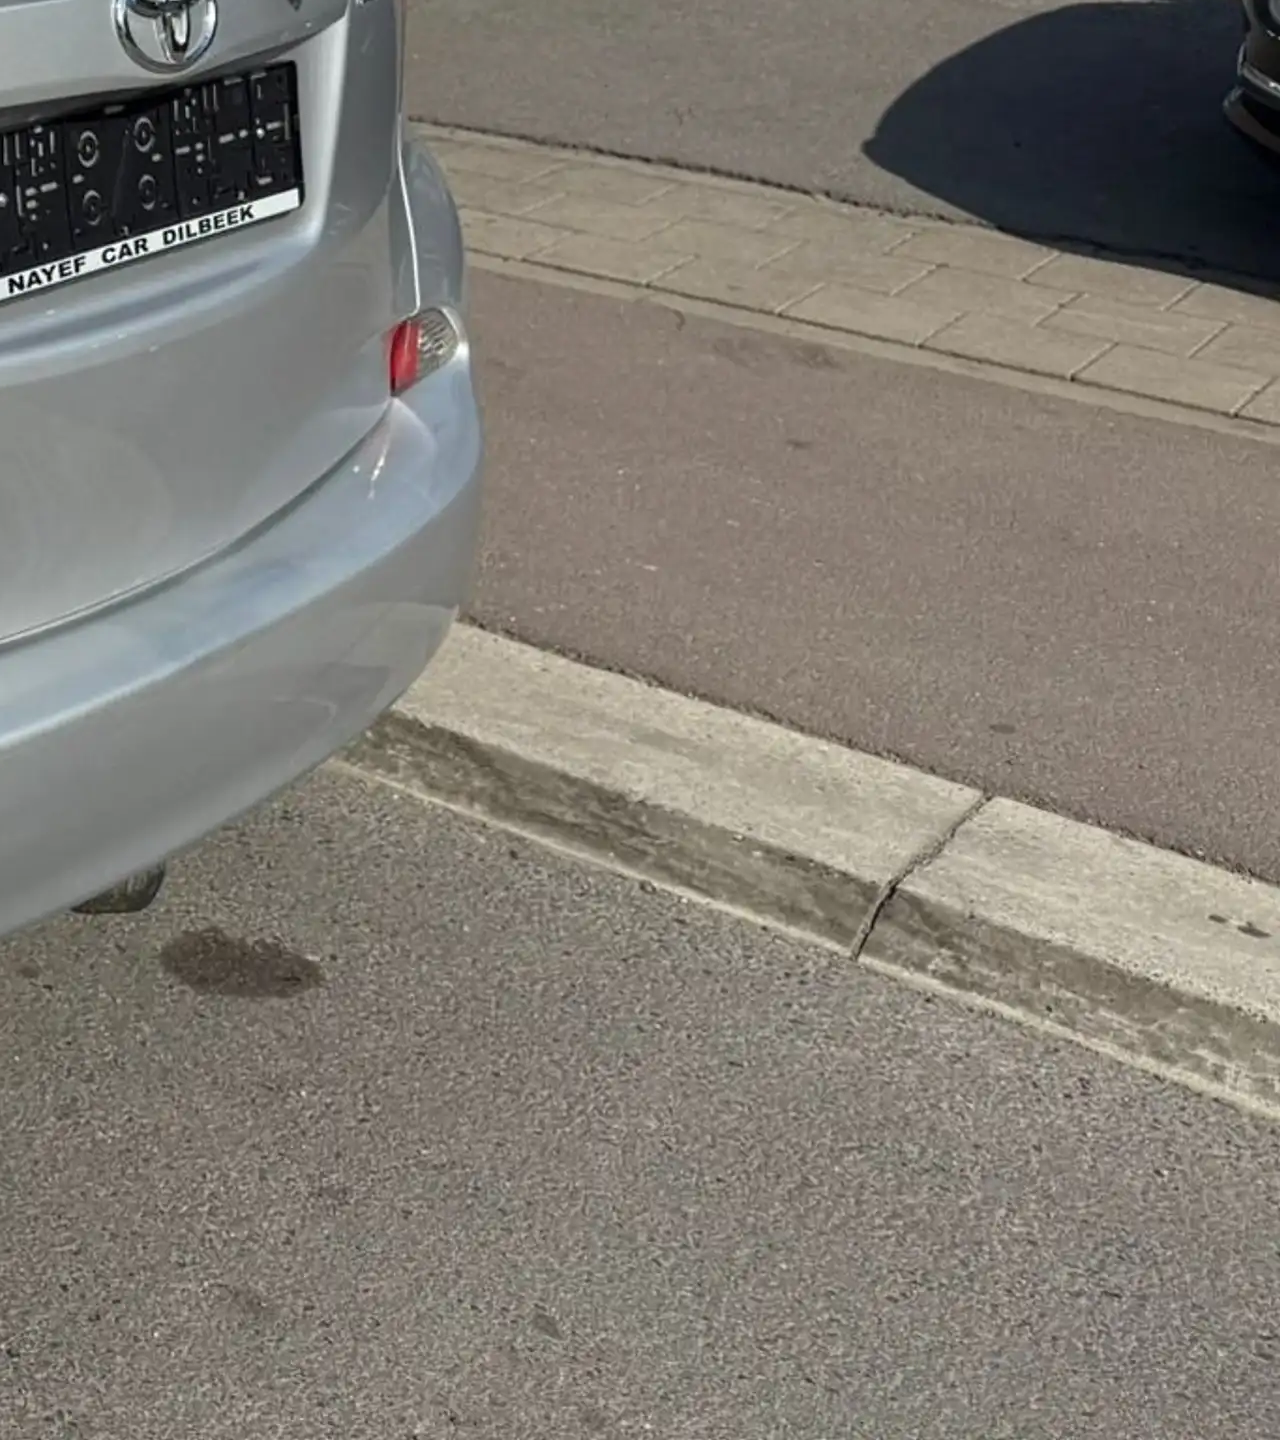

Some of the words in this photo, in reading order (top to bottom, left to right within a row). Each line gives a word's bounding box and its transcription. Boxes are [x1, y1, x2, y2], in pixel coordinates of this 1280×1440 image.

[7, 255, 87, 294] NAYEF
[101, 237, 149, 265] CAR
[162, 204, 255, 245] DILBEEK
